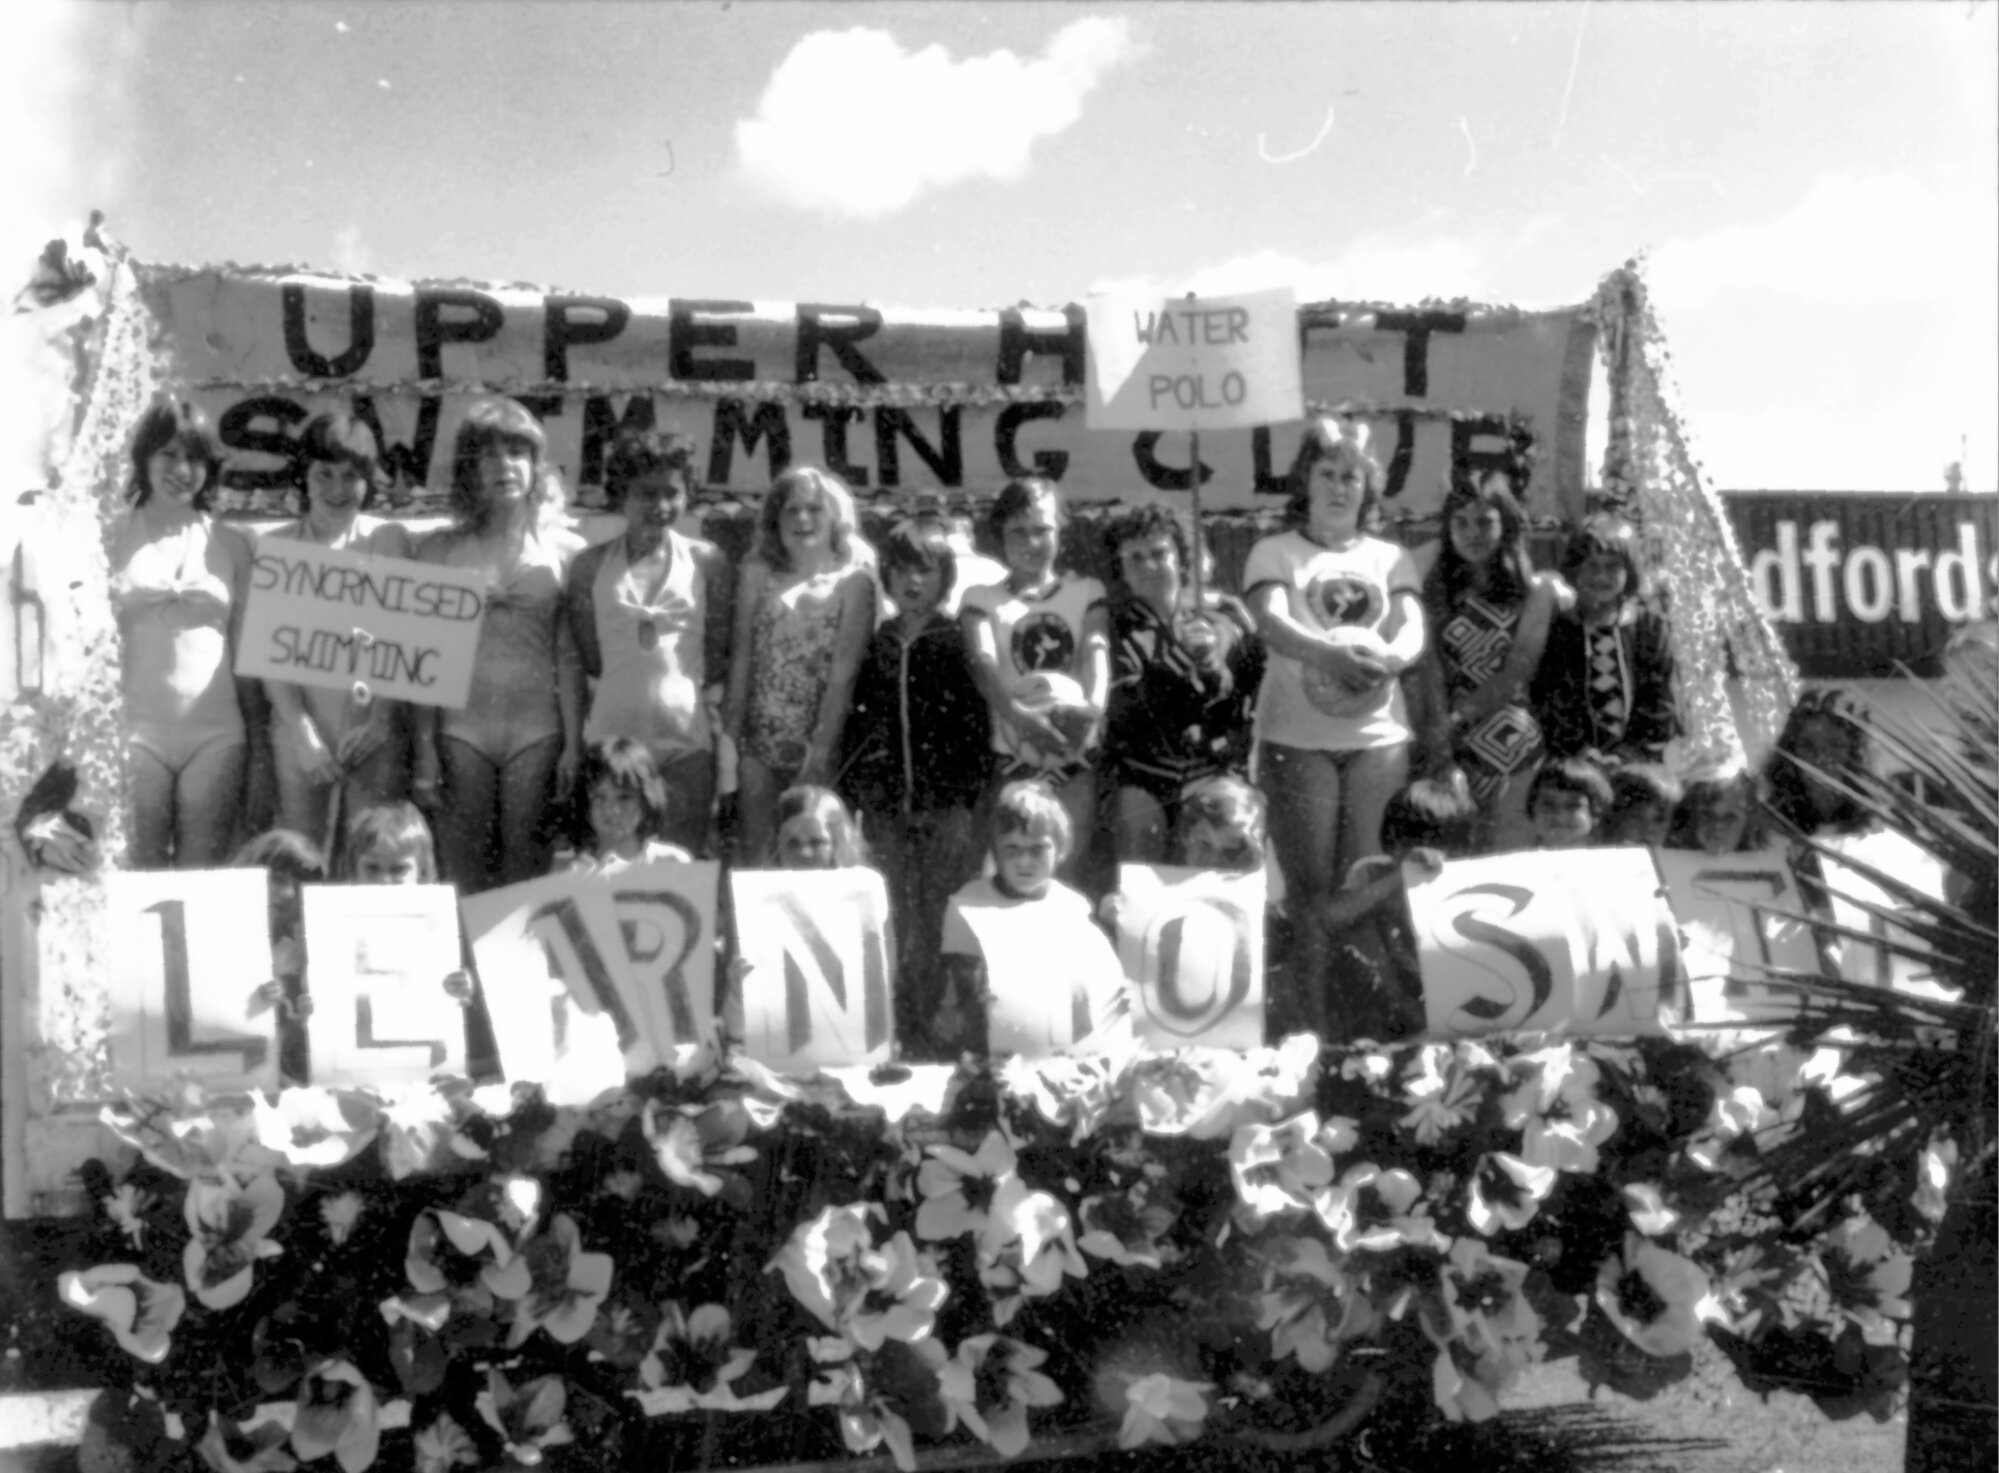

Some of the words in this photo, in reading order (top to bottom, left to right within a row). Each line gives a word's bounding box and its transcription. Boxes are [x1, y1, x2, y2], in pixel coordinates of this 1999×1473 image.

[281, 282, 887, 385] UPPER
[996, 302, 1467, 396] HT
[1134, 306, 1250, 344] WATER
[1149, 370, 1246, 411] POLO
[1751, 519, 1998, 623] dford
[141, 889, 890, 1082] LEARN
